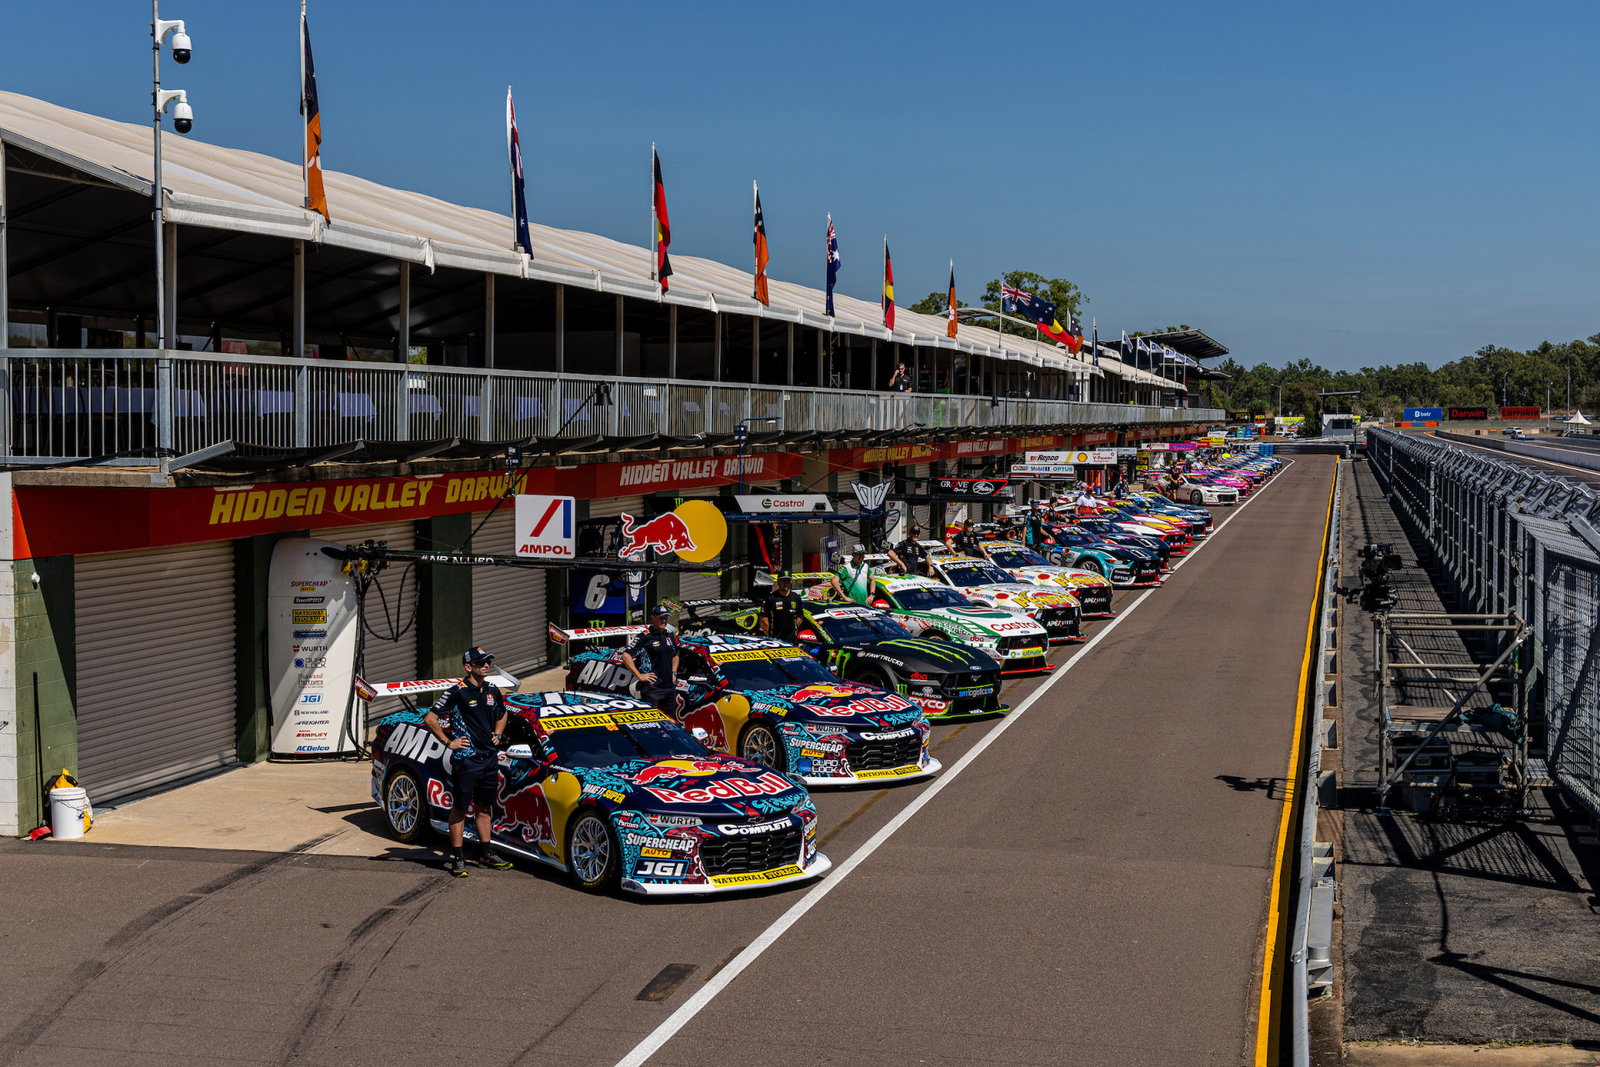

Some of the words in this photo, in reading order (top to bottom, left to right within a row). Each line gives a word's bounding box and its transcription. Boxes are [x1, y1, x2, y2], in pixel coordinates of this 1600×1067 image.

[1451, 409, 1485, 418] Darwin
[1503, 409, 1539, 417] Larrakia
[863, 448, 887, 463] HIDDEN
[887, 446, 910, 461] VALLEY
[1037, 454, 1060, 462] Repco
[619, 463, 670, 487] HIDDEN
[672, 459, 719, 480] VALLEY
[723, 457, 764, 477] DARWIN
[940, 480, 968, 489] GROVE
[209, 487, 327, 525] HIDDEN
[333, 480, 433, 513] VALLEY
[773, 499, 805, 508] Castrol
[519, 544, 572, 555] AMPOL
[291, 580, 328, 588] SUPERCHEAP
[584, 574, 610, 610] 6
[990, 621, 1041, 632] Castrol
[709, 640, 793, 653] AMPOL
[713, 651, 765, 662] NATIONAL
[403, 677, 465, 687] AMPL
[301, 695, 321, 703] JGI
[799, 700, 876, 716] Red
[860, 694, 912, 712] Bull
[540, 700, 651, 717] AMPOL
[542, 715, 611, 731] NATIONAL
[613, 710, 667, 724] STORAGE
[628, 721, 662, 730] Feeney
[860, 728, 914, 740] COMPLETE
[789, 737, 843, 753] SUPERCHEAP
[812, 759, 839, 767] QUAD
[857, 770, 896, 779] NATIONAL
[427, 778, 454, 810] Re
[641, 780, 743, 803] Red
[724, 772, 793, 797] Bull
[603, 789, 626, 804] SUPER
[717, 819, 793, 836] COMPLETE
[626, 832, 695, 851] SUPERCHEAP
[636, 861, 685, 877] JGI
[713, 874, 765, 885] NATIONAL
[765, 865, 802, 879] STORAGE
